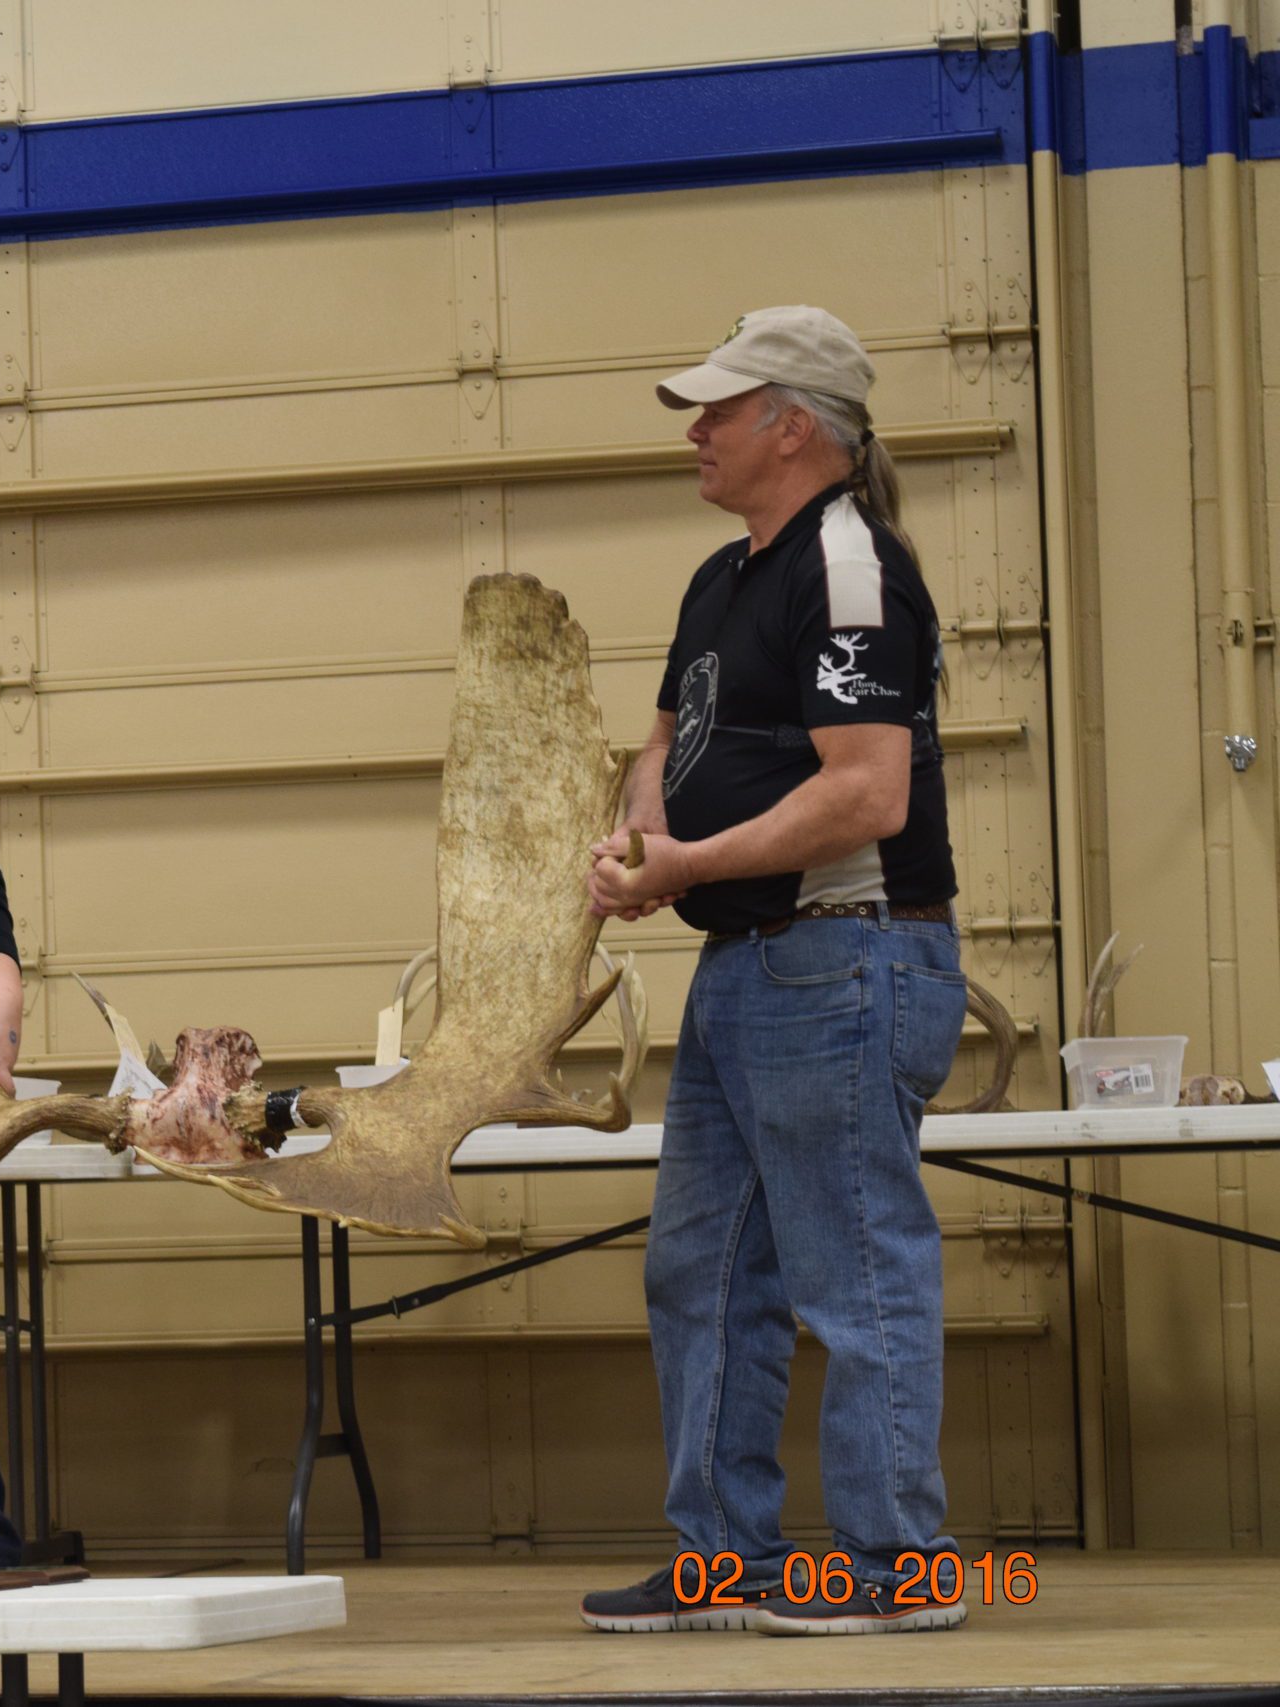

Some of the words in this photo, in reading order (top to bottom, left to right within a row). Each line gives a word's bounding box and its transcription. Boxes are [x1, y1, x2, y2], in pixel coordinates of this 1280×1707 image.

[852, 679, 877, 689] Hunt
[848, 685, 869, 696] Fair
[870, 685, 901, 697] Chase
